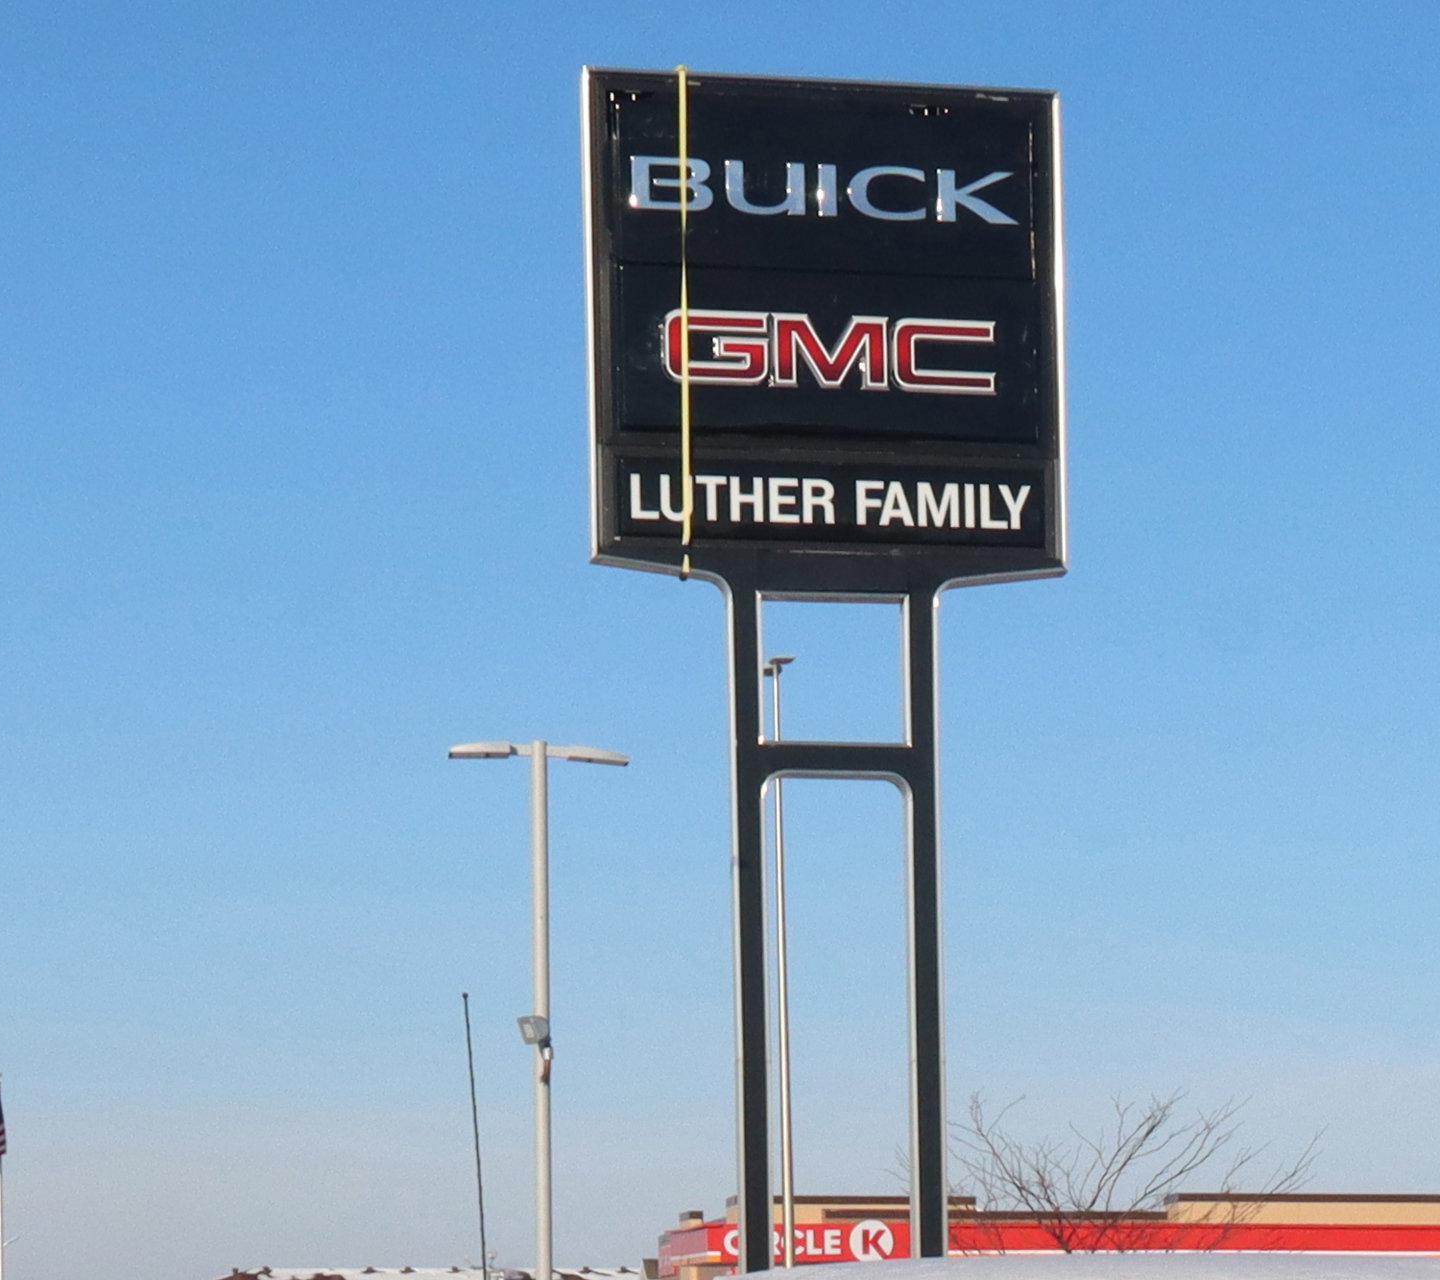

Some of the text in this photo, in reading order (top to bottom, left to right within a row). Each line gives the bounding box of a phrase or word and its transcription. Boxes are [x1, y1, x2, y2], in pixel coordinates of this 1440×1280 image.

[628, 155, 1018, 226] BUICK
[661, 307, 998, 396] GMC
[630, 472, 1032, 531] LUTHER FAMILY
[723, 1228, 888, 1259] CCLE K
